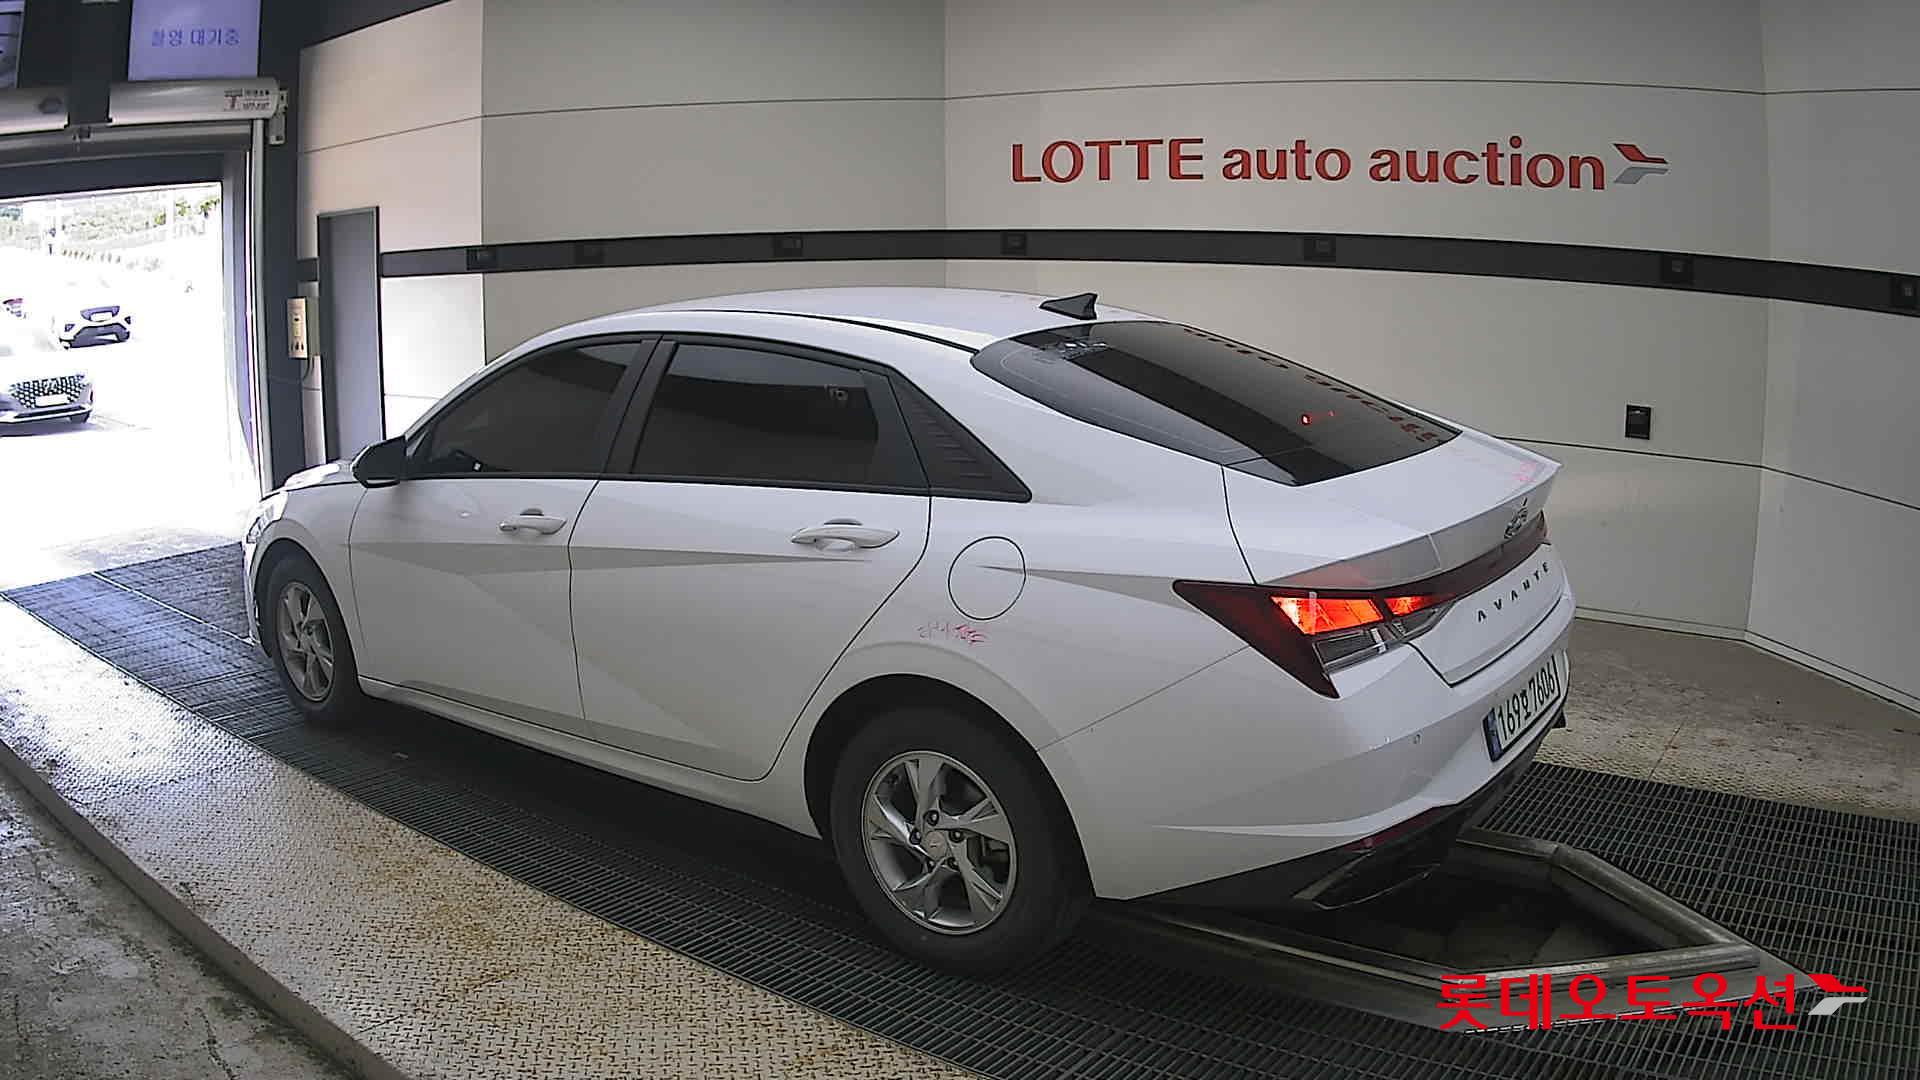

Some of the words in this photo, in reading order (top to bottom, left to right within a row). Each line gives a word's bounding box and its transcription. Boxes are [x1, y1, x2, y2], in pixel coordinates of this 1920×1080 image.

[190, 28, 240, 46] 대기중
[1012, 138, 1203, 183] LOTTE
[1222, 139, 1351, 182] auto
[1369, 136, 1606, 190] auction
[1477, 561, 1549, 623] AVANTE
